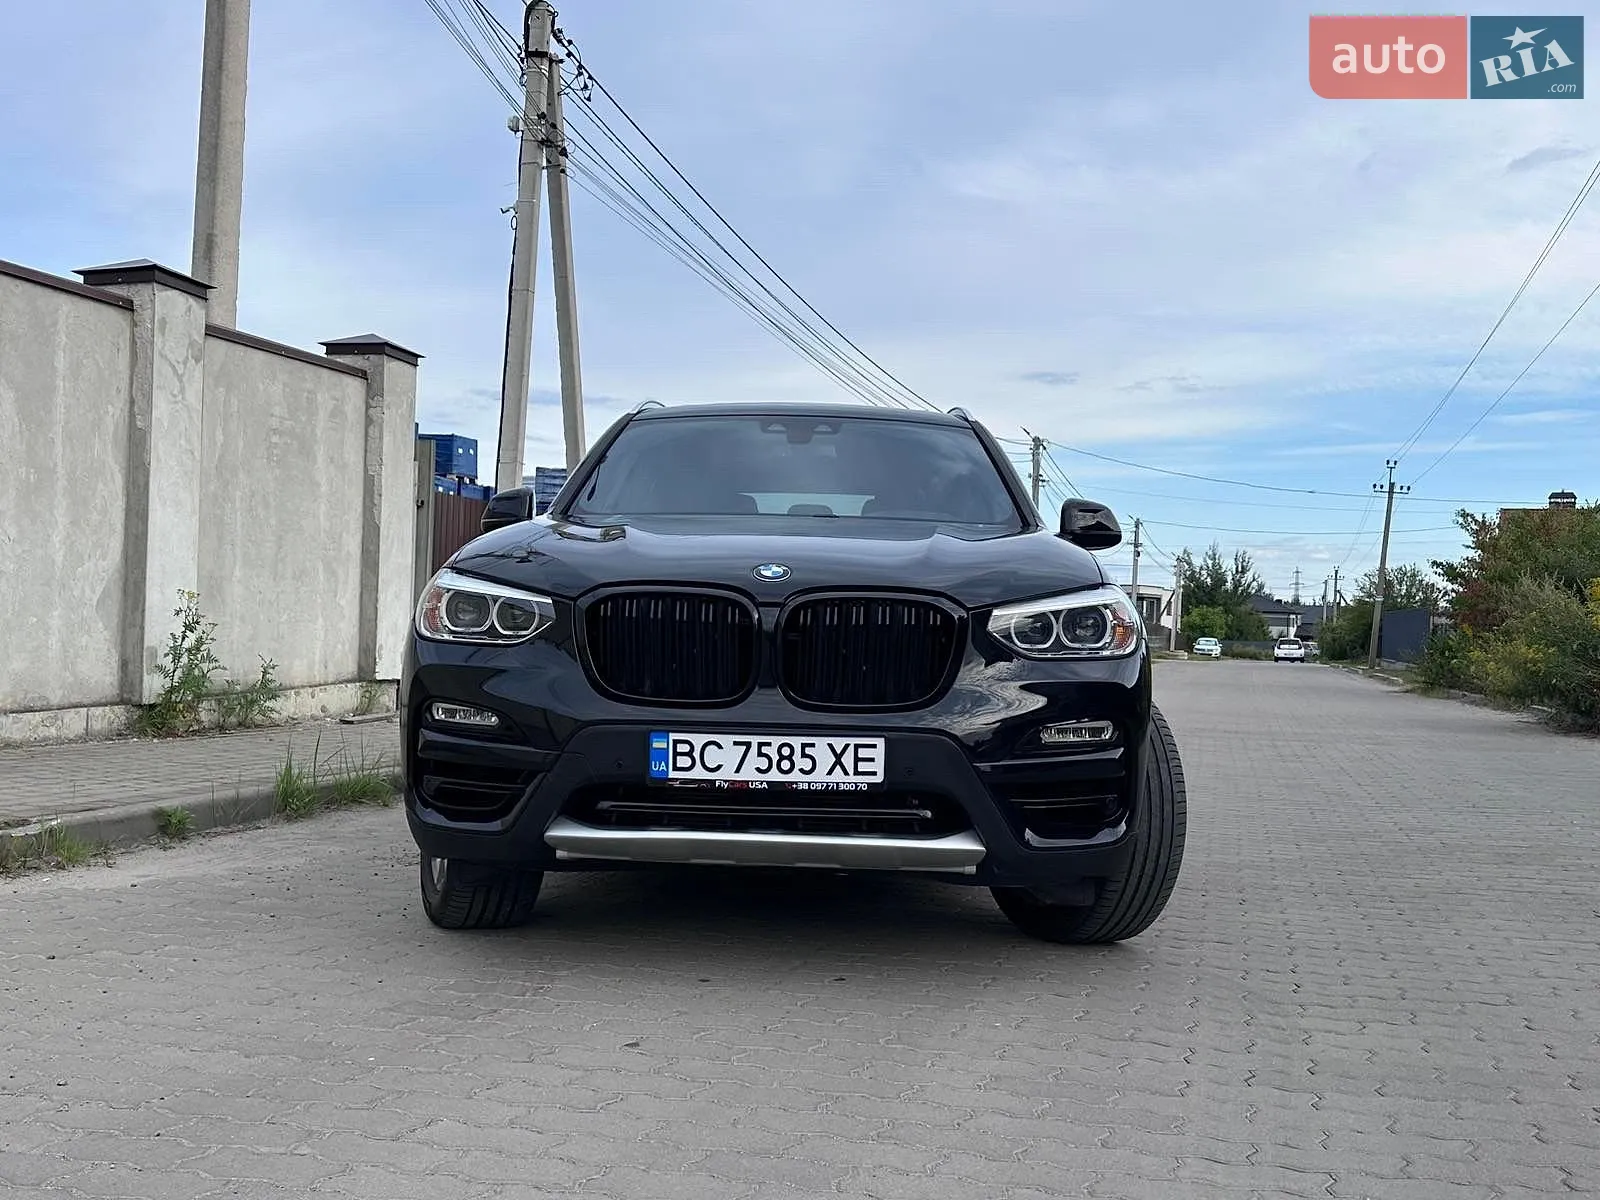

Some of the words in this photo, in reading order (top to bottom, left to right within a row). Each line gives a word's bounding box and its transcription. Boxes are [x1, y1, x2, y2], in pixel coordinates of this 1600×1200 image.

[671, 739, 724, 773] BC
[732, 740, 817, 775] 7585
[826, 742, 878, 777] XE
[652, 761, 667, 772] UA
[749, 781, 768, 789] USA
